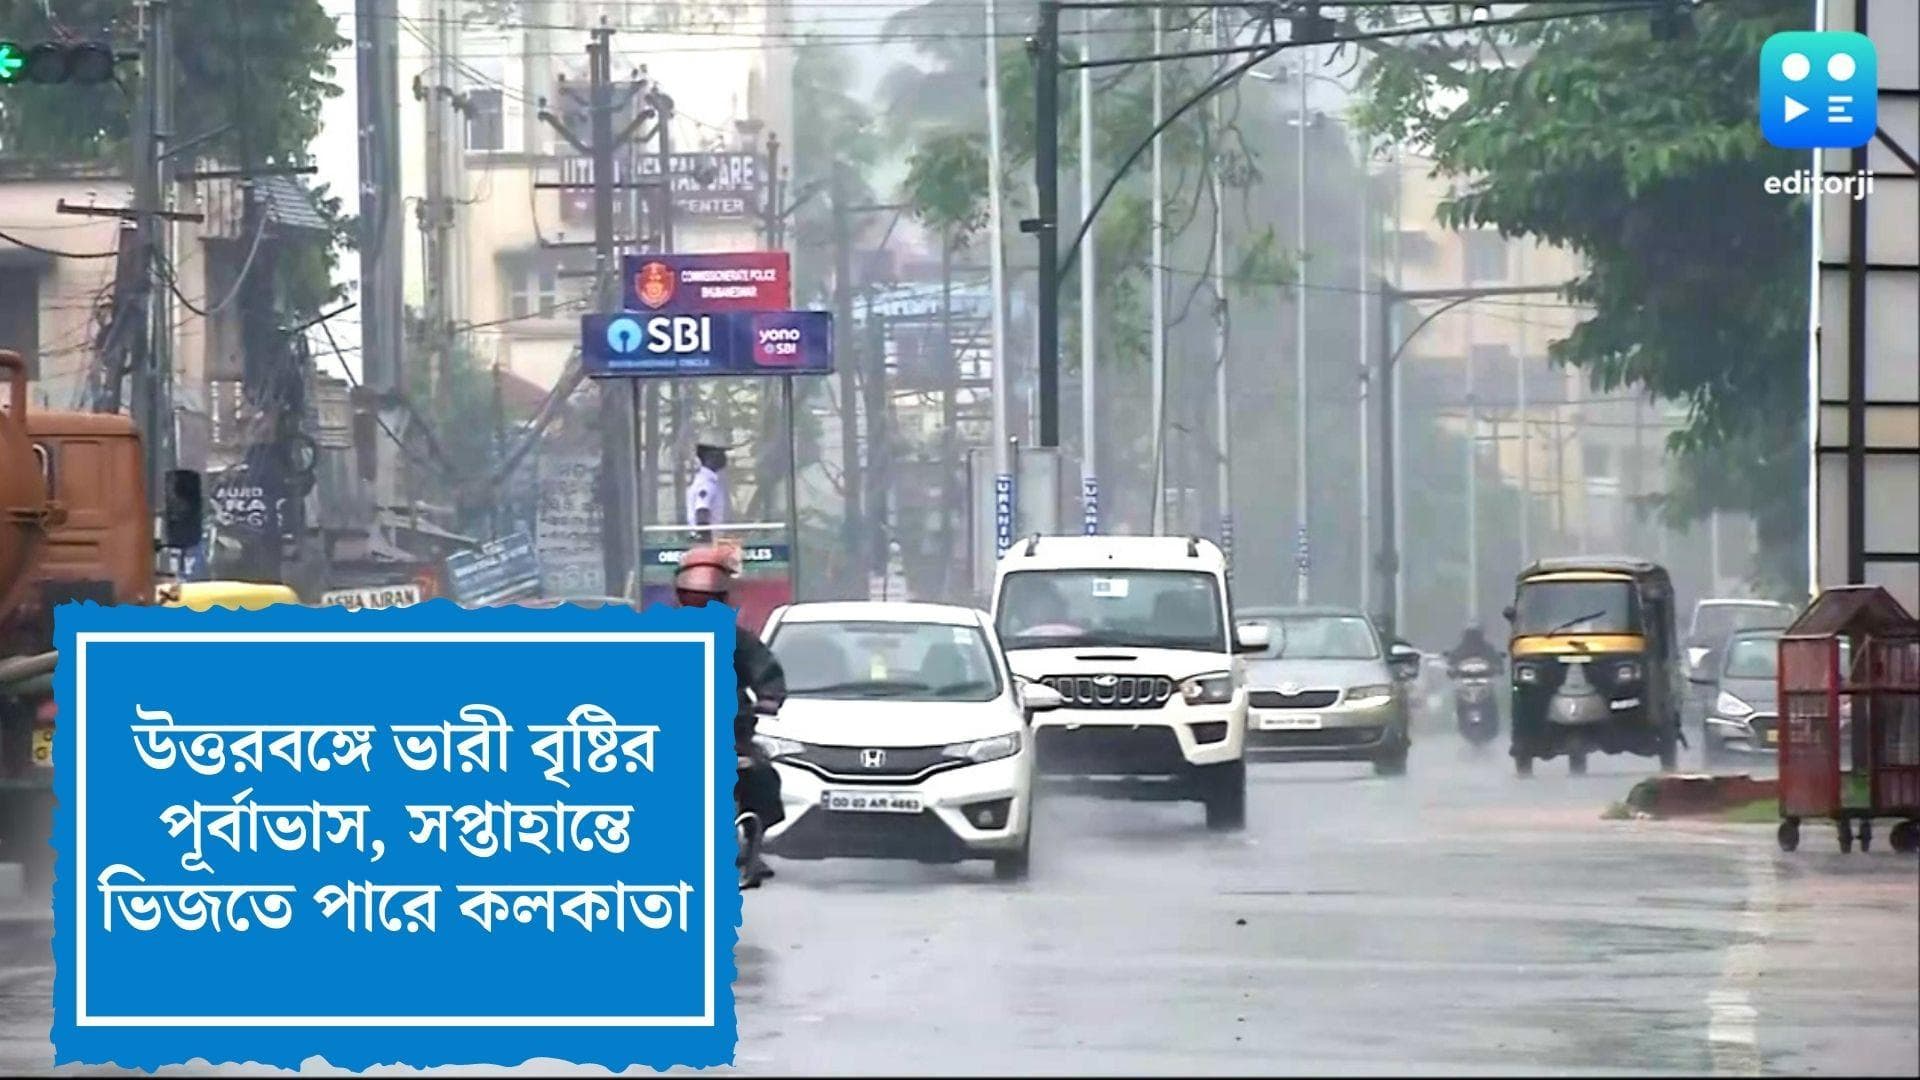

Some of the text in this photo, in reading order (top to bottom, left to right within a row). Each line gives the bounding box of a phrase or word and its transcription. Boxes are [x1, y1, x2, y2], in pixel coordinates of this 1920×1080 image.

[647, 317, 711, 353] SBI
[759, 329, 800, 344] yono
[776, 343, 797, 355] SBI
